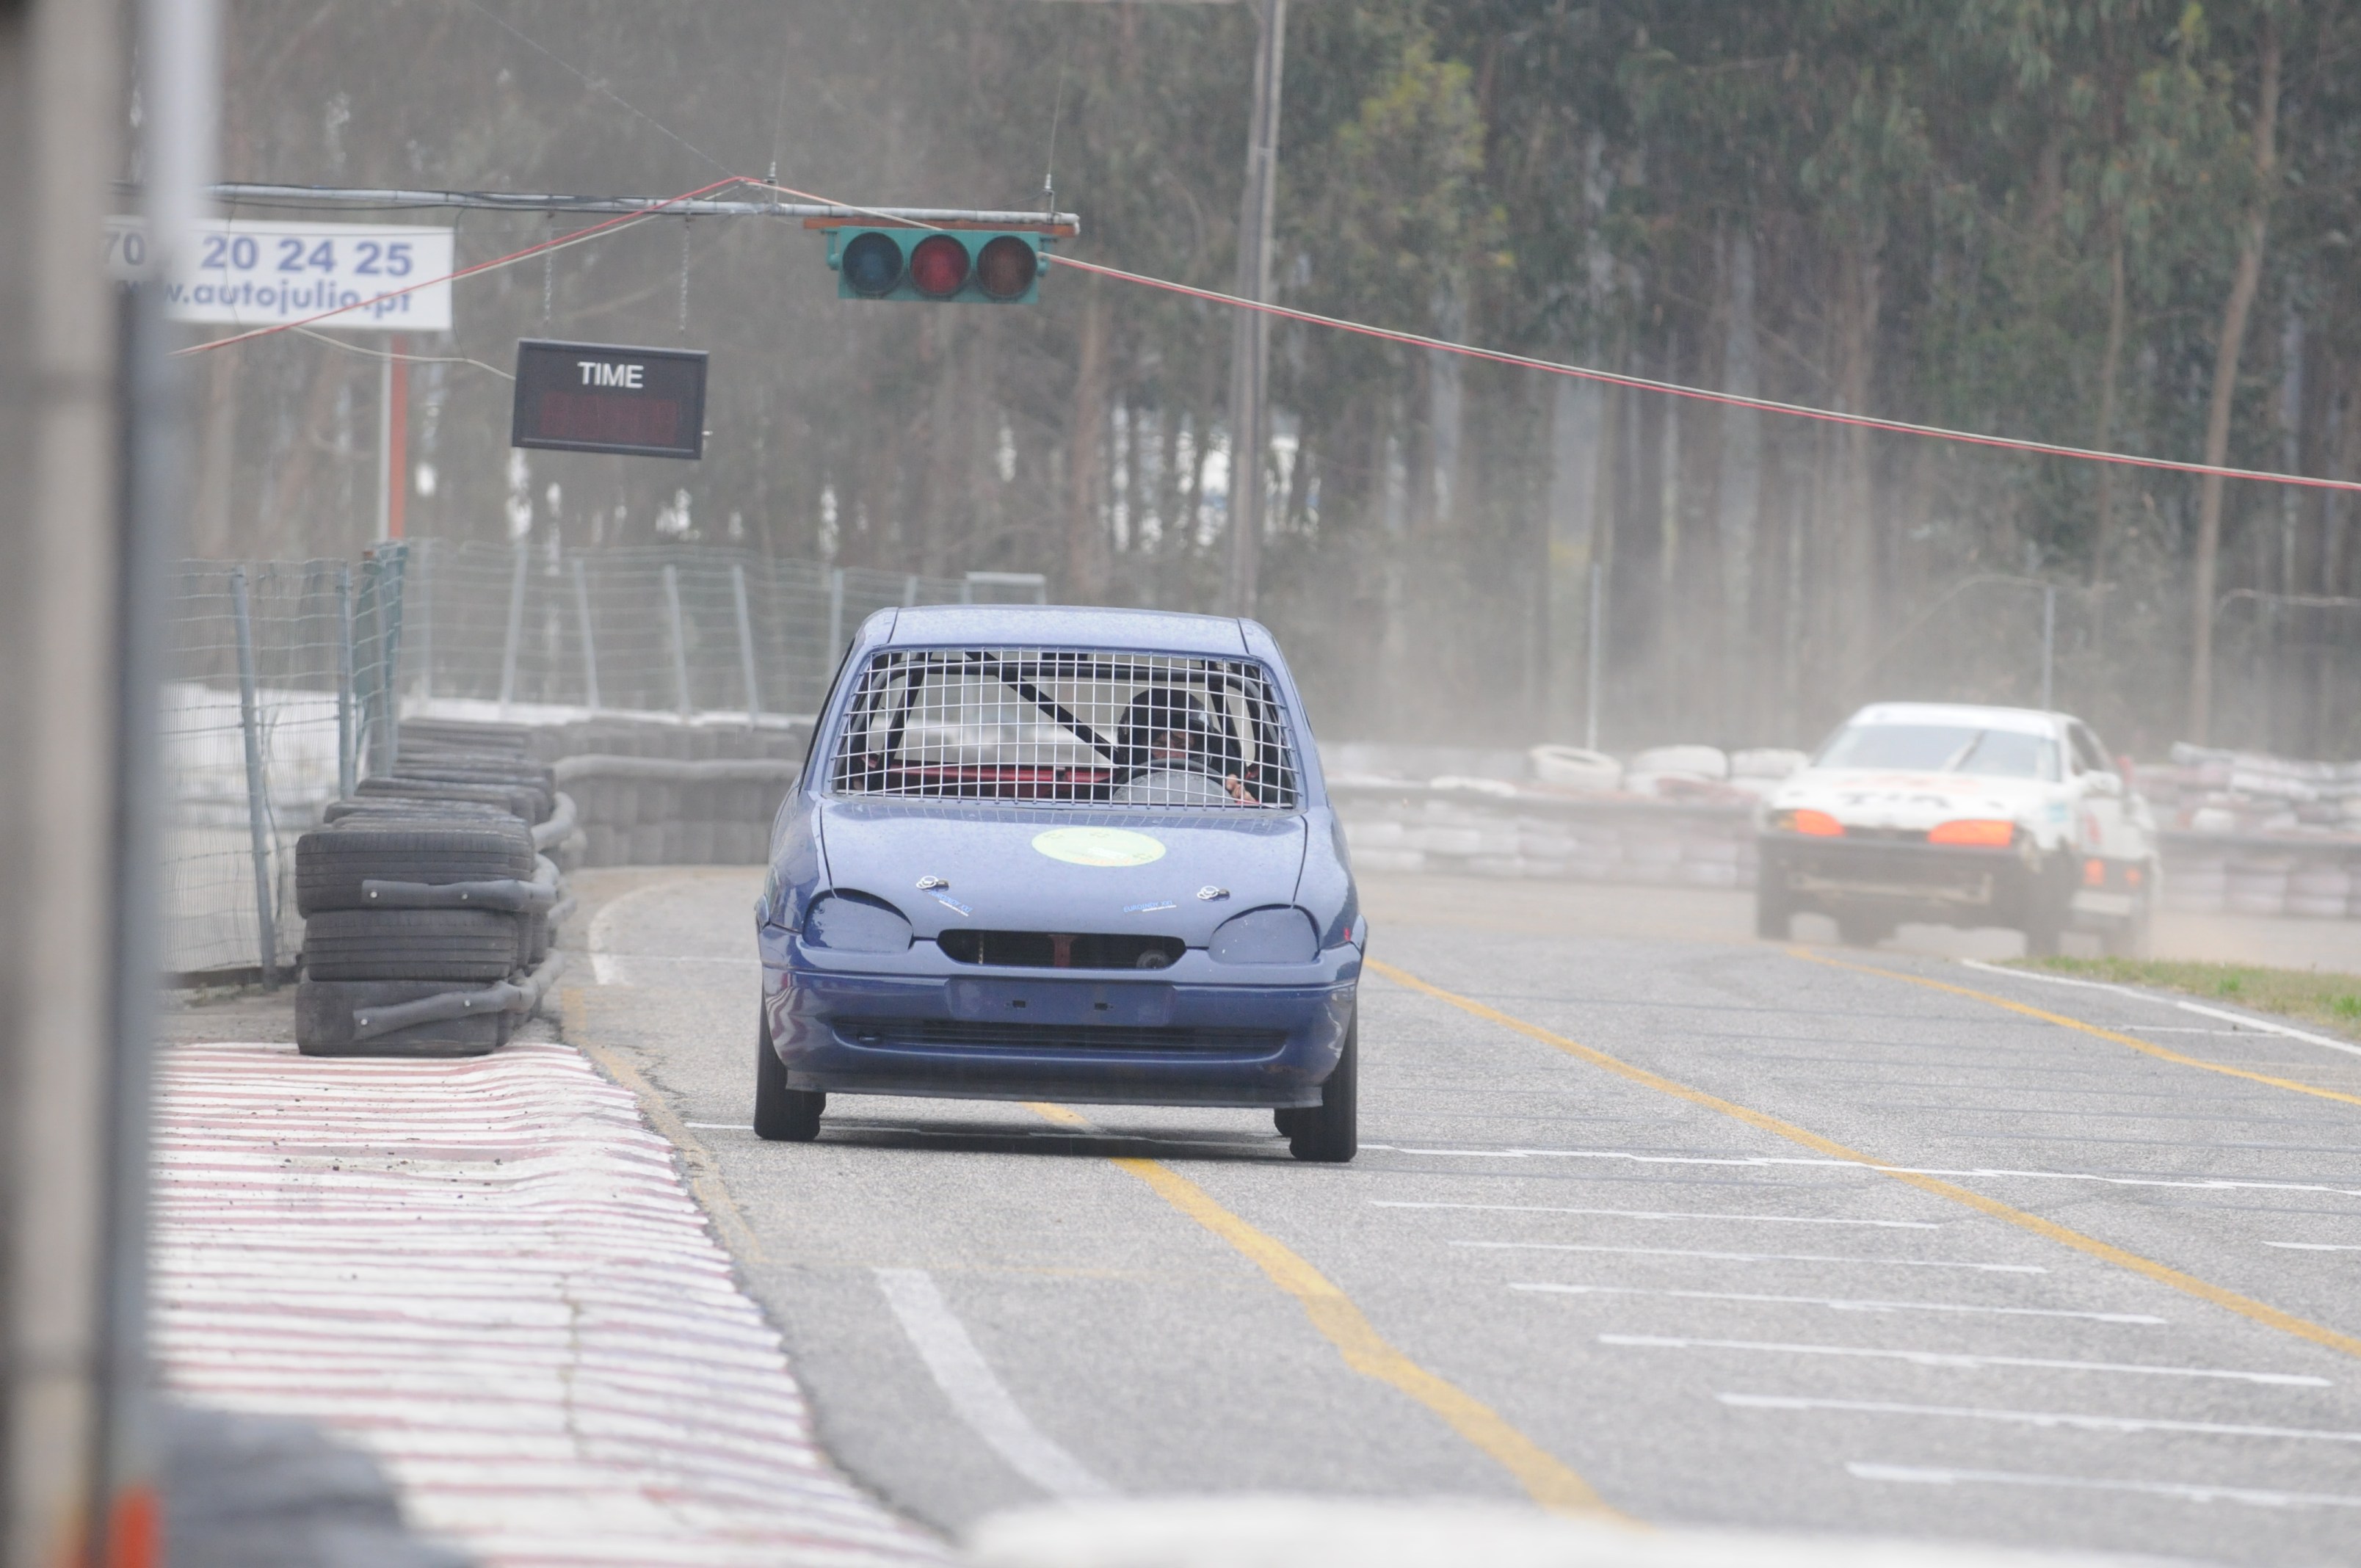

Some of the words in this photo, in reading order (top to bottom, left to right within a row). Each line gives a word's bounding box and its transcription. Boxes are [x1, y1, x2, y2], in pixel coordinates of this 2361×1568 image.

[200, 235, 258, 270] 20
[277, 237, 336, 273] 24
[355, 240, 413, 276] 25
[577, 361, 644, 389] TIME
